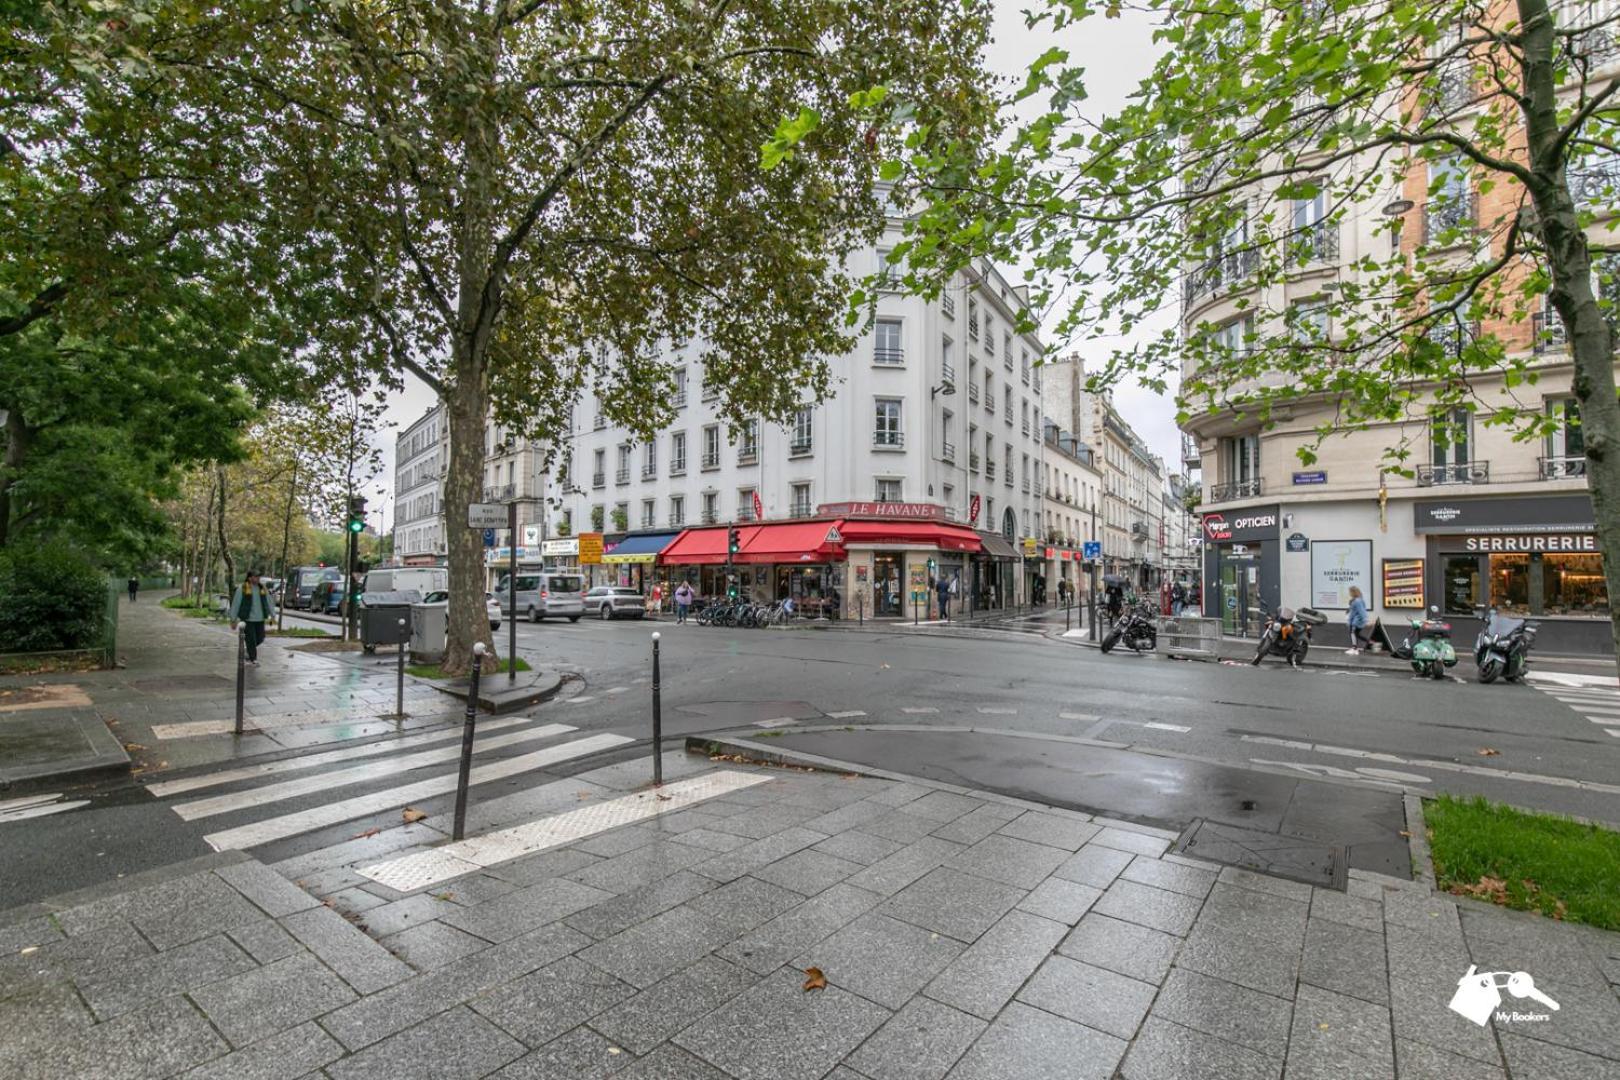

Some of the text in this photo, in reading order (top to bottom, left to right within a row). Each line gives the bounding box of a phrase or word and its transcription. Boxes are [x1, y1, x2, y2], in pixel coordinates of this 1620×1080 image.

[852, 503, 929, 516] LE HAVANE
[1235, 515, 1275, 529] OPTICIEN
[1466, 536, 1594, 550] SERRURERIE
